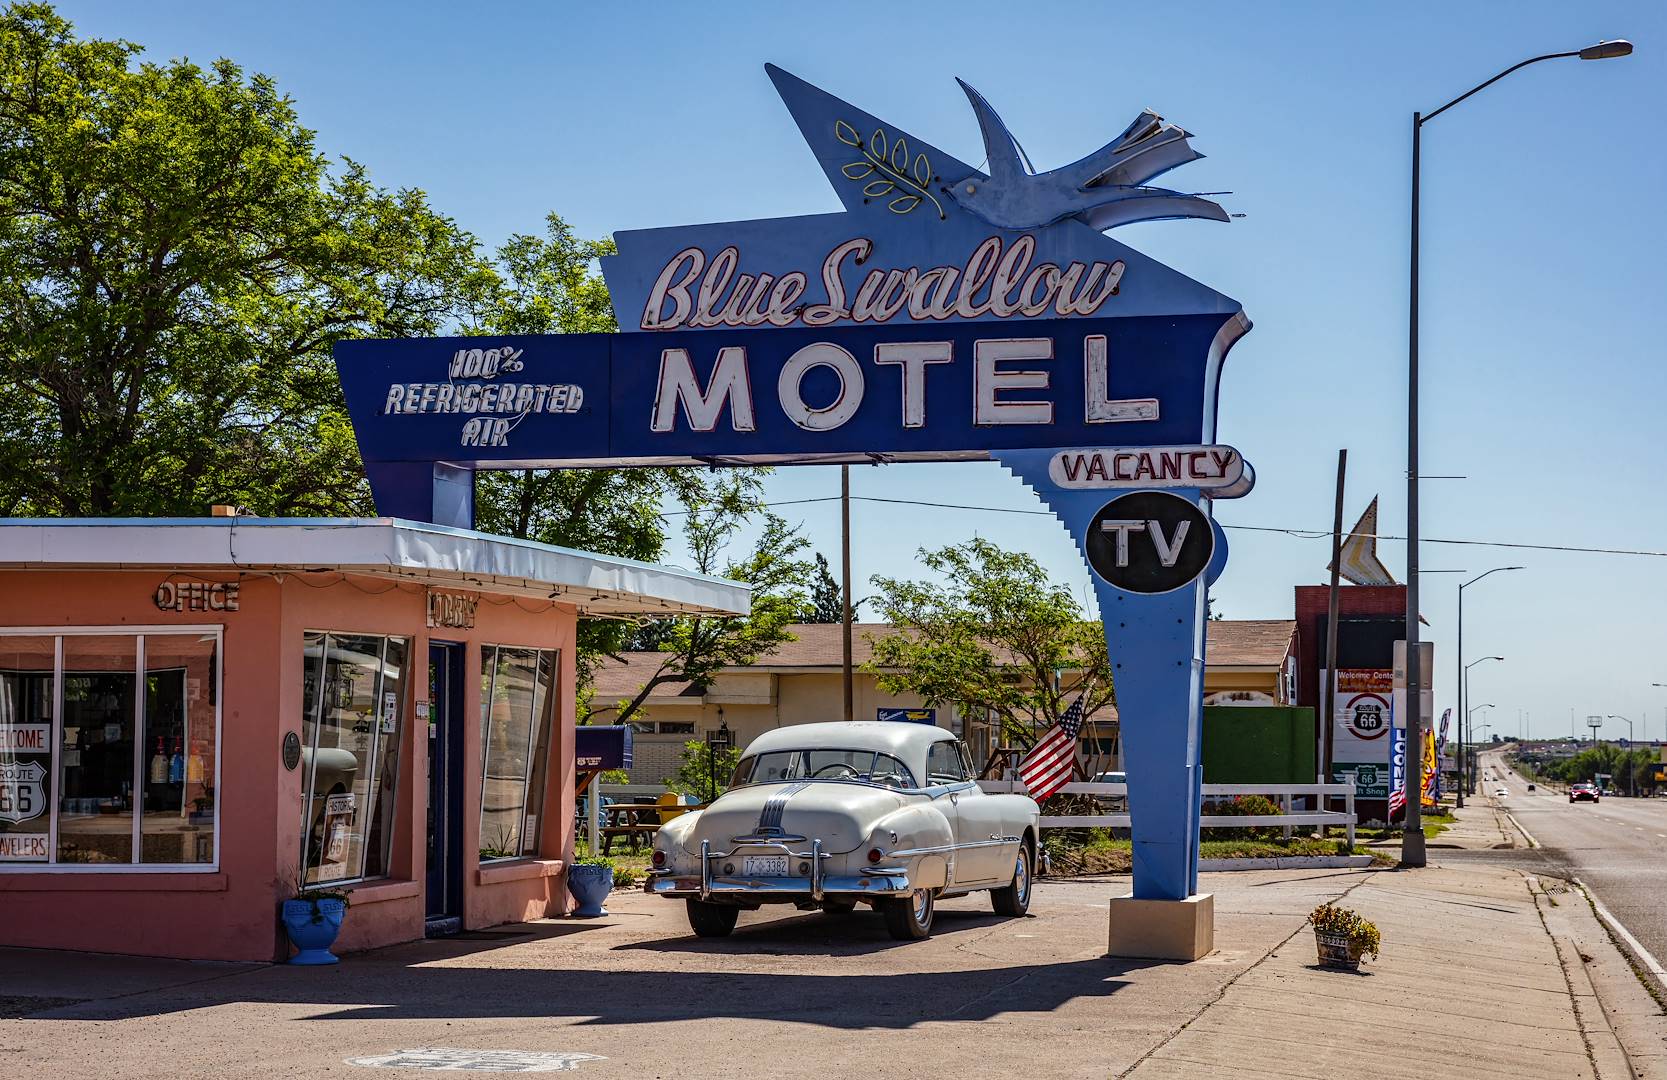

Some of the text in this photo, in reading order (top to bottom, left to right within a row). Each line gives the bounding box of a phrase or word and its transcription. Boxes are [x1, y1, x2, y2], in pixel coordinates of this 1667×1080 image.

[641, 235, 1126, 330] Blue Swallow
[449, 346, 524, 379] 100%
[650, 334, 1161, 433] MOTEL
[384, 383, 584, 415] REFRIGERATED
[461, 417, 509, 447] AIR
[1062, 452, 1235, 481] VACANCY
[1101, 519, 1191, 567] TV
[154, 582, 240, 611] OFFICE
[1339, 671, 1370, 679] Welcome
[1360, 713, 1377, 728] 66
[1361, 774, 1373, 783] 66
[1366, 787, 1386, 796] Shop
